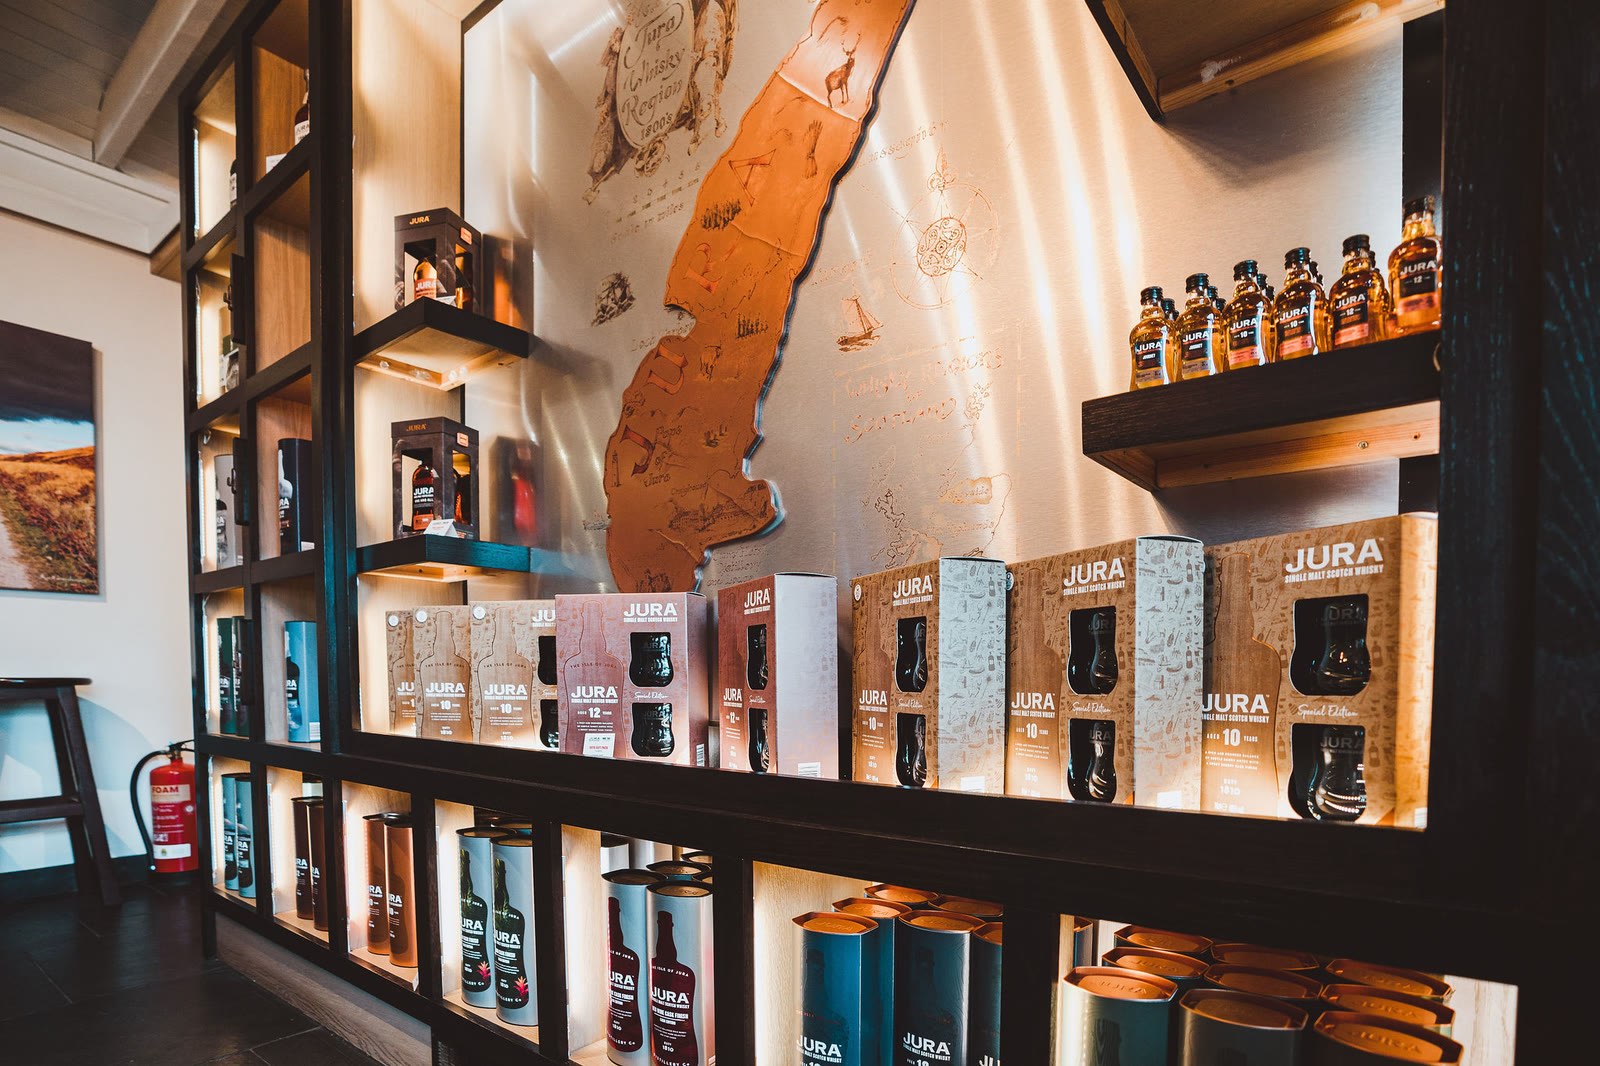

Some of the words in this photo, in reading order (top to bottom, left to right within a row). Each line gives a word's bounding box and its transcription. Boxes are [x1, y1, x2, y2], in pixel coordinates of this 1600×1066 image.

[624, 48, 685, 92] Whisky
[622, 80, 682, 126] Region
[409, 216, 430, 225] JURA
[1400, 260, 1437, 275] JURA
[1335, 293, 1366, 309] JURA
[1279, 306, 1309, 321] JURA
[1230, 318, 1257, 331] JURA
[1182, 331, 1209, 343] JURA
[1136, 342, 1162, 352] JURA
[406, 424, 427, 432] JURA
[413, 486, 434, 496] JURA
[279, 497, 290, 507] RA
[1285, 538, 1384, 573] JURA
[1063, 557, 1126, 587] JURA
[1284, 572, 1307, 584] SINGLE
[1307, 570, 1326, 581] MALT
[1326, 567, 1354, 579] SCOTCH
[1354, 564, 1384, 576] WHISKY
[893, 575, 933, 599] JURA
[1077, 585, 1089, 594] MALT
[1089, 582, 1107, 592] SCOTCH
[1107, 580, 1126, 590] WHISKY
[744, 588, 771, 609] JURA
[532, 609, 556, 622] JU
[623, 603, 678, 617] JURA
[286, 680, 297, 688] RA
[397, 681, 415, 692] JU
[425, 682, 466, 693] JURA
[484, 684, 528, 695] JURA
[571, 685, 618, 698] JURA
[723, 687, 743, 702] JURA
[859, 689, 888, 706] JURA
[410, 698, 415, 708] 1
[440, 700, 452, 710] 10
[1011, 692, 1055, 710] JURA
[1072, 701, 1090, 715] Special
[1091, 702, 1111, 714] Edition
[1202, 693, 1270, 714] JURA
[500, 703, 512, 714] 10
[588, 707, 601, 718] 12
[1297, 703, 1326, 720] Special
[1327, 704, 1358, 718] Edition
[868, 717, 877, 731] 10
[1202, 713, 1215, 721] INGLE
[1215, 713, 1228, 721] MALT
[1229, 714, 1248, 722] SCOTCH
[1249, 715, 1270, 724] WHISKY
[1026, 722, 1038, 739] 10
[1222, 728, 1241, 747] 10
[152, 785, 179, 793] FOAM
[238, 841, 248, 849] RA
[296, 858, 308, 867] RA
[369, 885, 382, 894] RA
[462, 918, 484, 930] URA
[495, 930, 521, 944] URA
[609, 971, 635, 986] URA
[652, 986, 690, 1004] JURA
[662, 1045, 674, 1053] 1810
[796, 1034, 842, 1058] JURA
[903, 1032, 950, 1055] JURA
